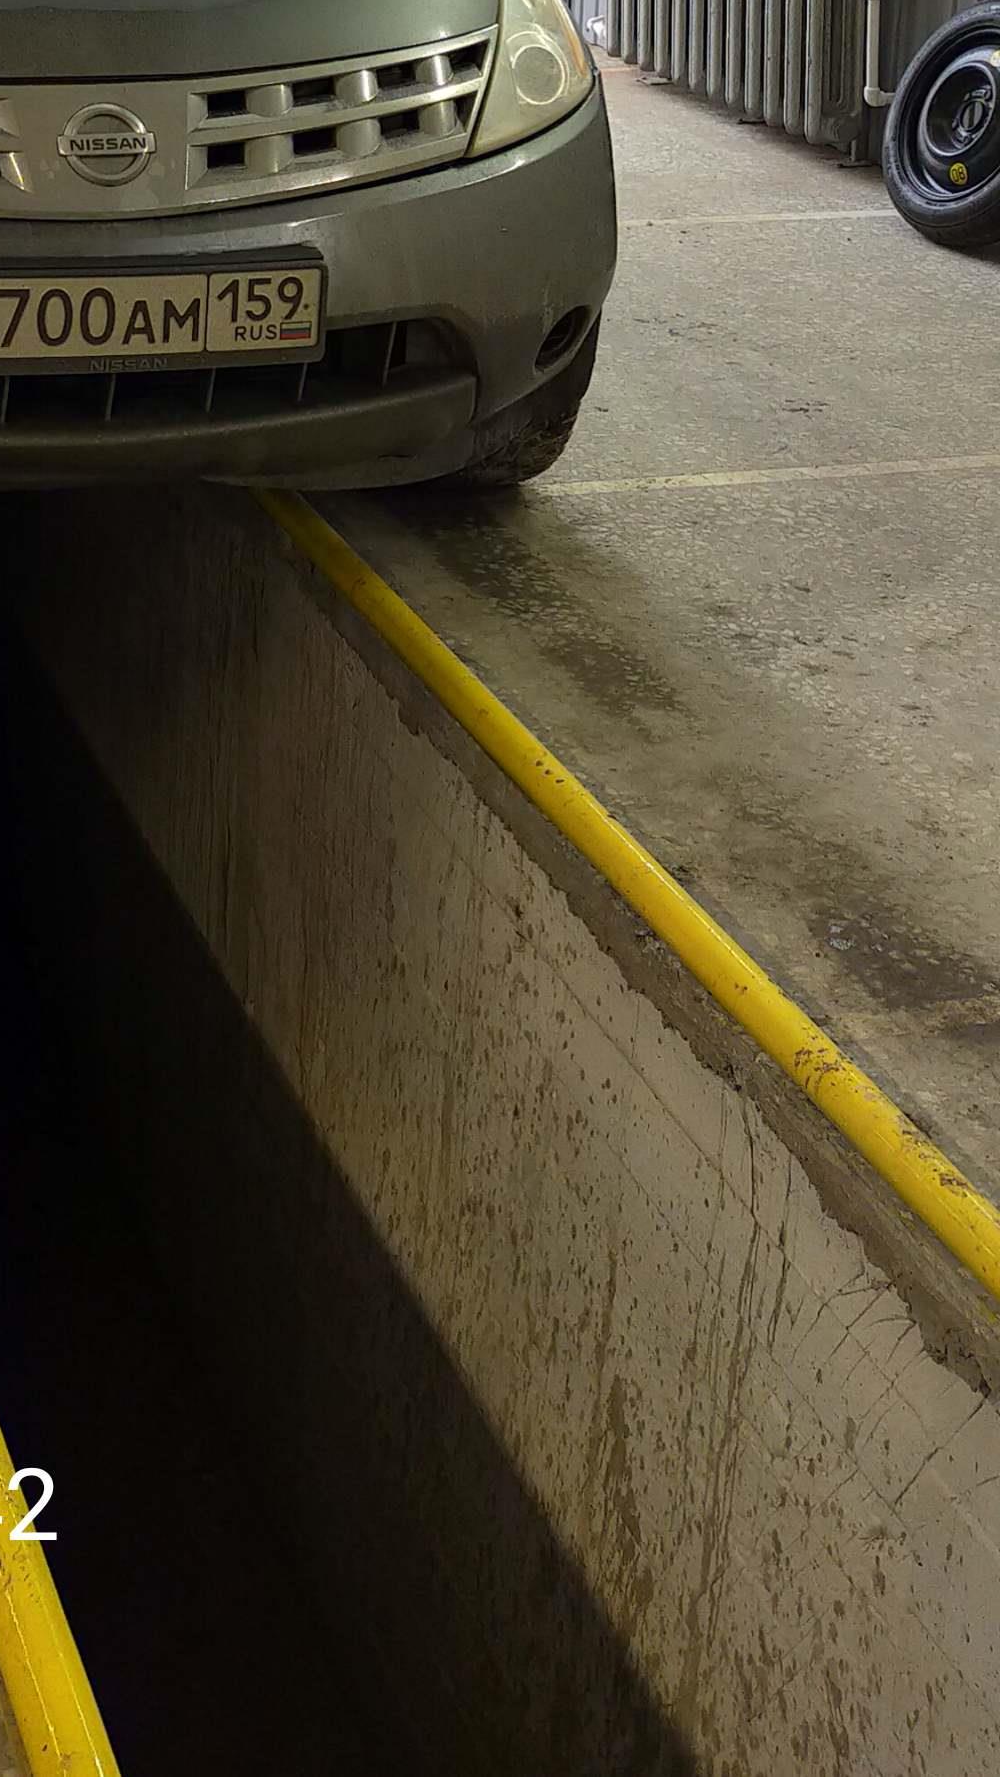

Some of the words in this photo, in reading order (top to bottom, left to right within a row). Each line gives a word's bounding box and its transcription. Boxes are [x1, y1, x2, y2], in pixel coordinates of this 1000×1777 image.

[69, 136, 147, 152] NISSAN
[216, 276, 304, 323] 159
[234, 325, 278, 343] RUS
[89, 357, 169, 373] NISSAN
